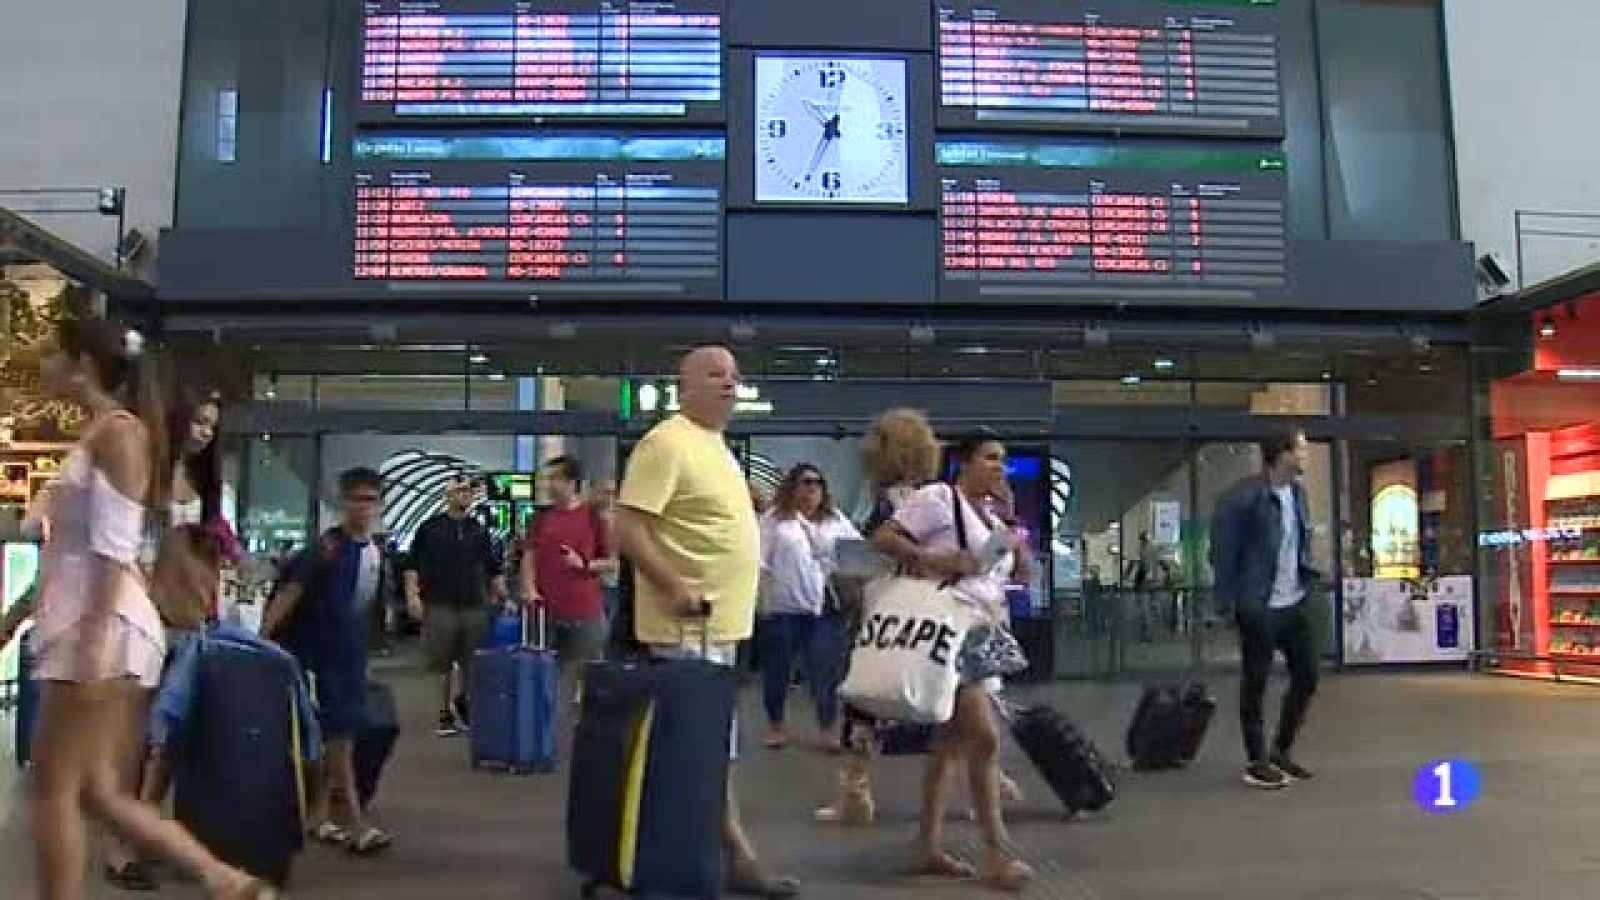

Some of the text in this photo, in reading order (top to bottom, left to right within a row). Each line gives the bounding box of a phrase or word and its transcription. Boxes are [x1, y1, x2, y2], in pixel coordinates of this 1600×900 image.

[819, 69, 846, 89] 12
[769, 119, 786, 138] 9
[822, 172, 840, 190] 6
